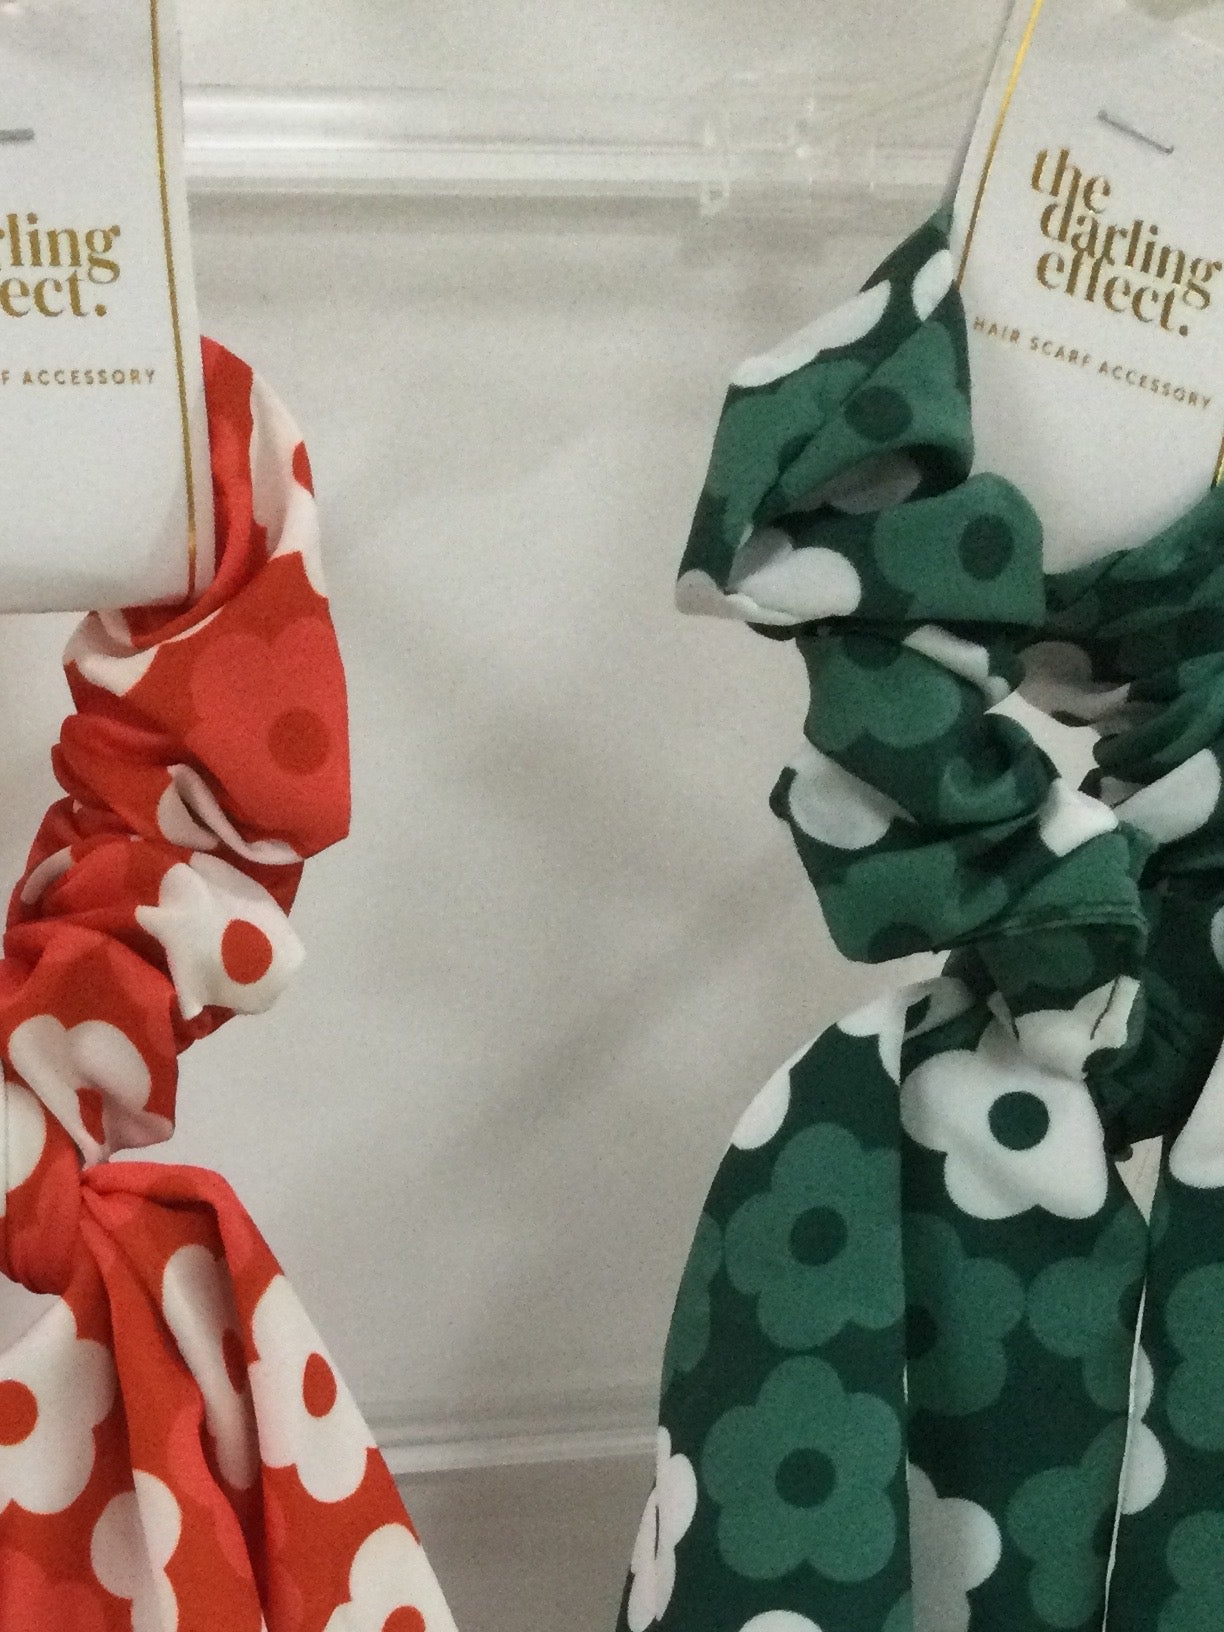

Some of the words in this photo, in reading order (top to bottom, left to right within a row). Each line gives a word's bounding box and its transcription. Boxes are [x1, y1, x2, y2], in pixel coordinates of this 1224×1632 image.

[1031, 148, 1112, 214] the
[1035, 248, 1189, 337] effect.
[1039, 200, 1223, 311] darling
[22, 367, 157, 387] ACCESSORY
[973, 316, 1021, 344] HAIR
[1029, 335, 1094, 369] SCARF
[1098, 360, 1212, 410] ACCESSORY
